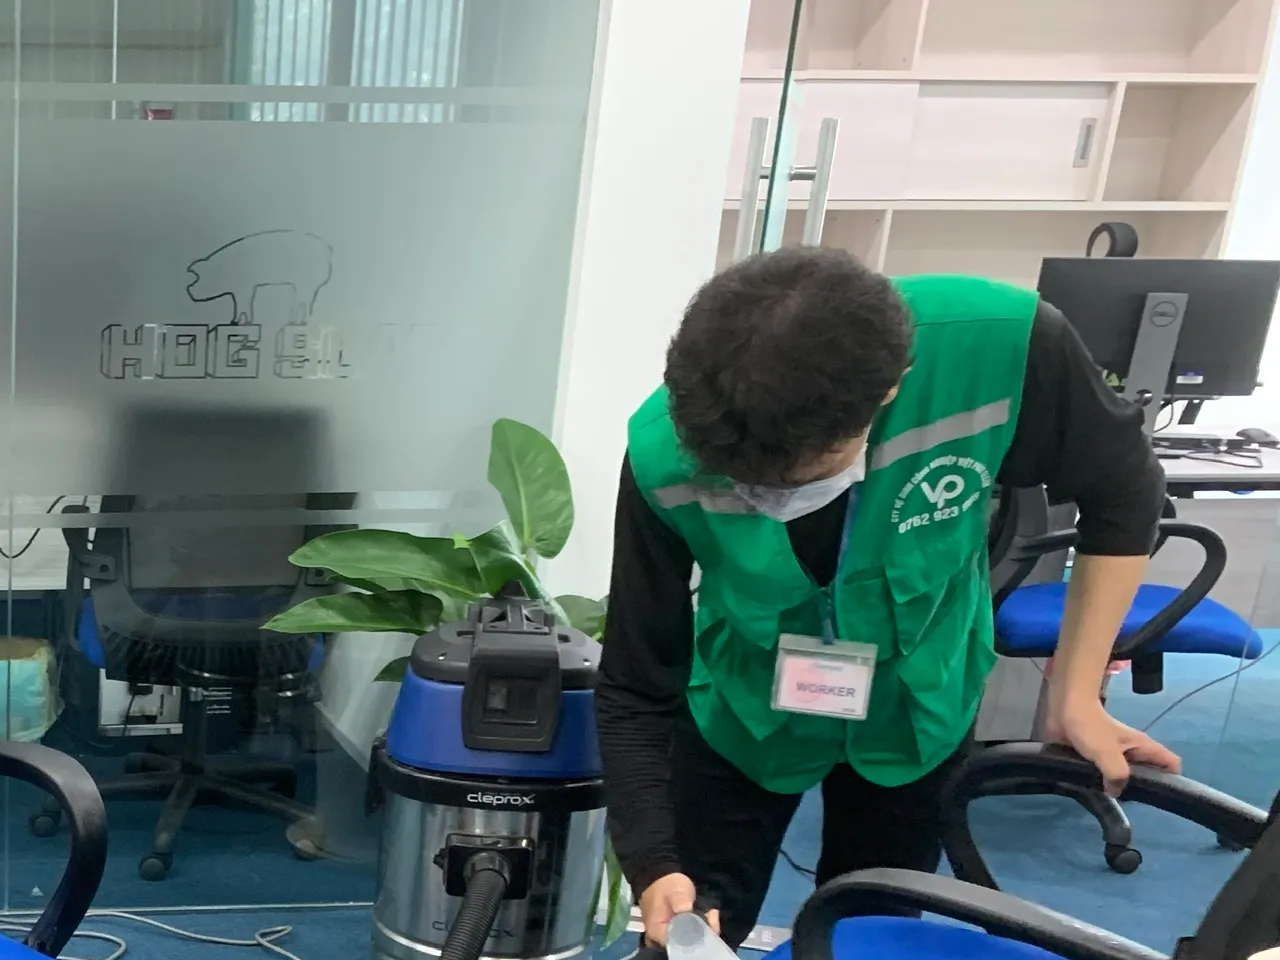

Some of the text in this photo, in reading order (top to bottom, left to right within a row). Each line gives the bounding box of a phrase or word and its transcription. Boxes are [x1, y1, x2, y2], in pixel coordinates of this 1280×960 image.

[101, 323, 262, 380] HOG
[898, 505, 960, 534] 0762 923
[796, 682, 857, 699] WORKER
[466, 792, 537, 807] cleprox
